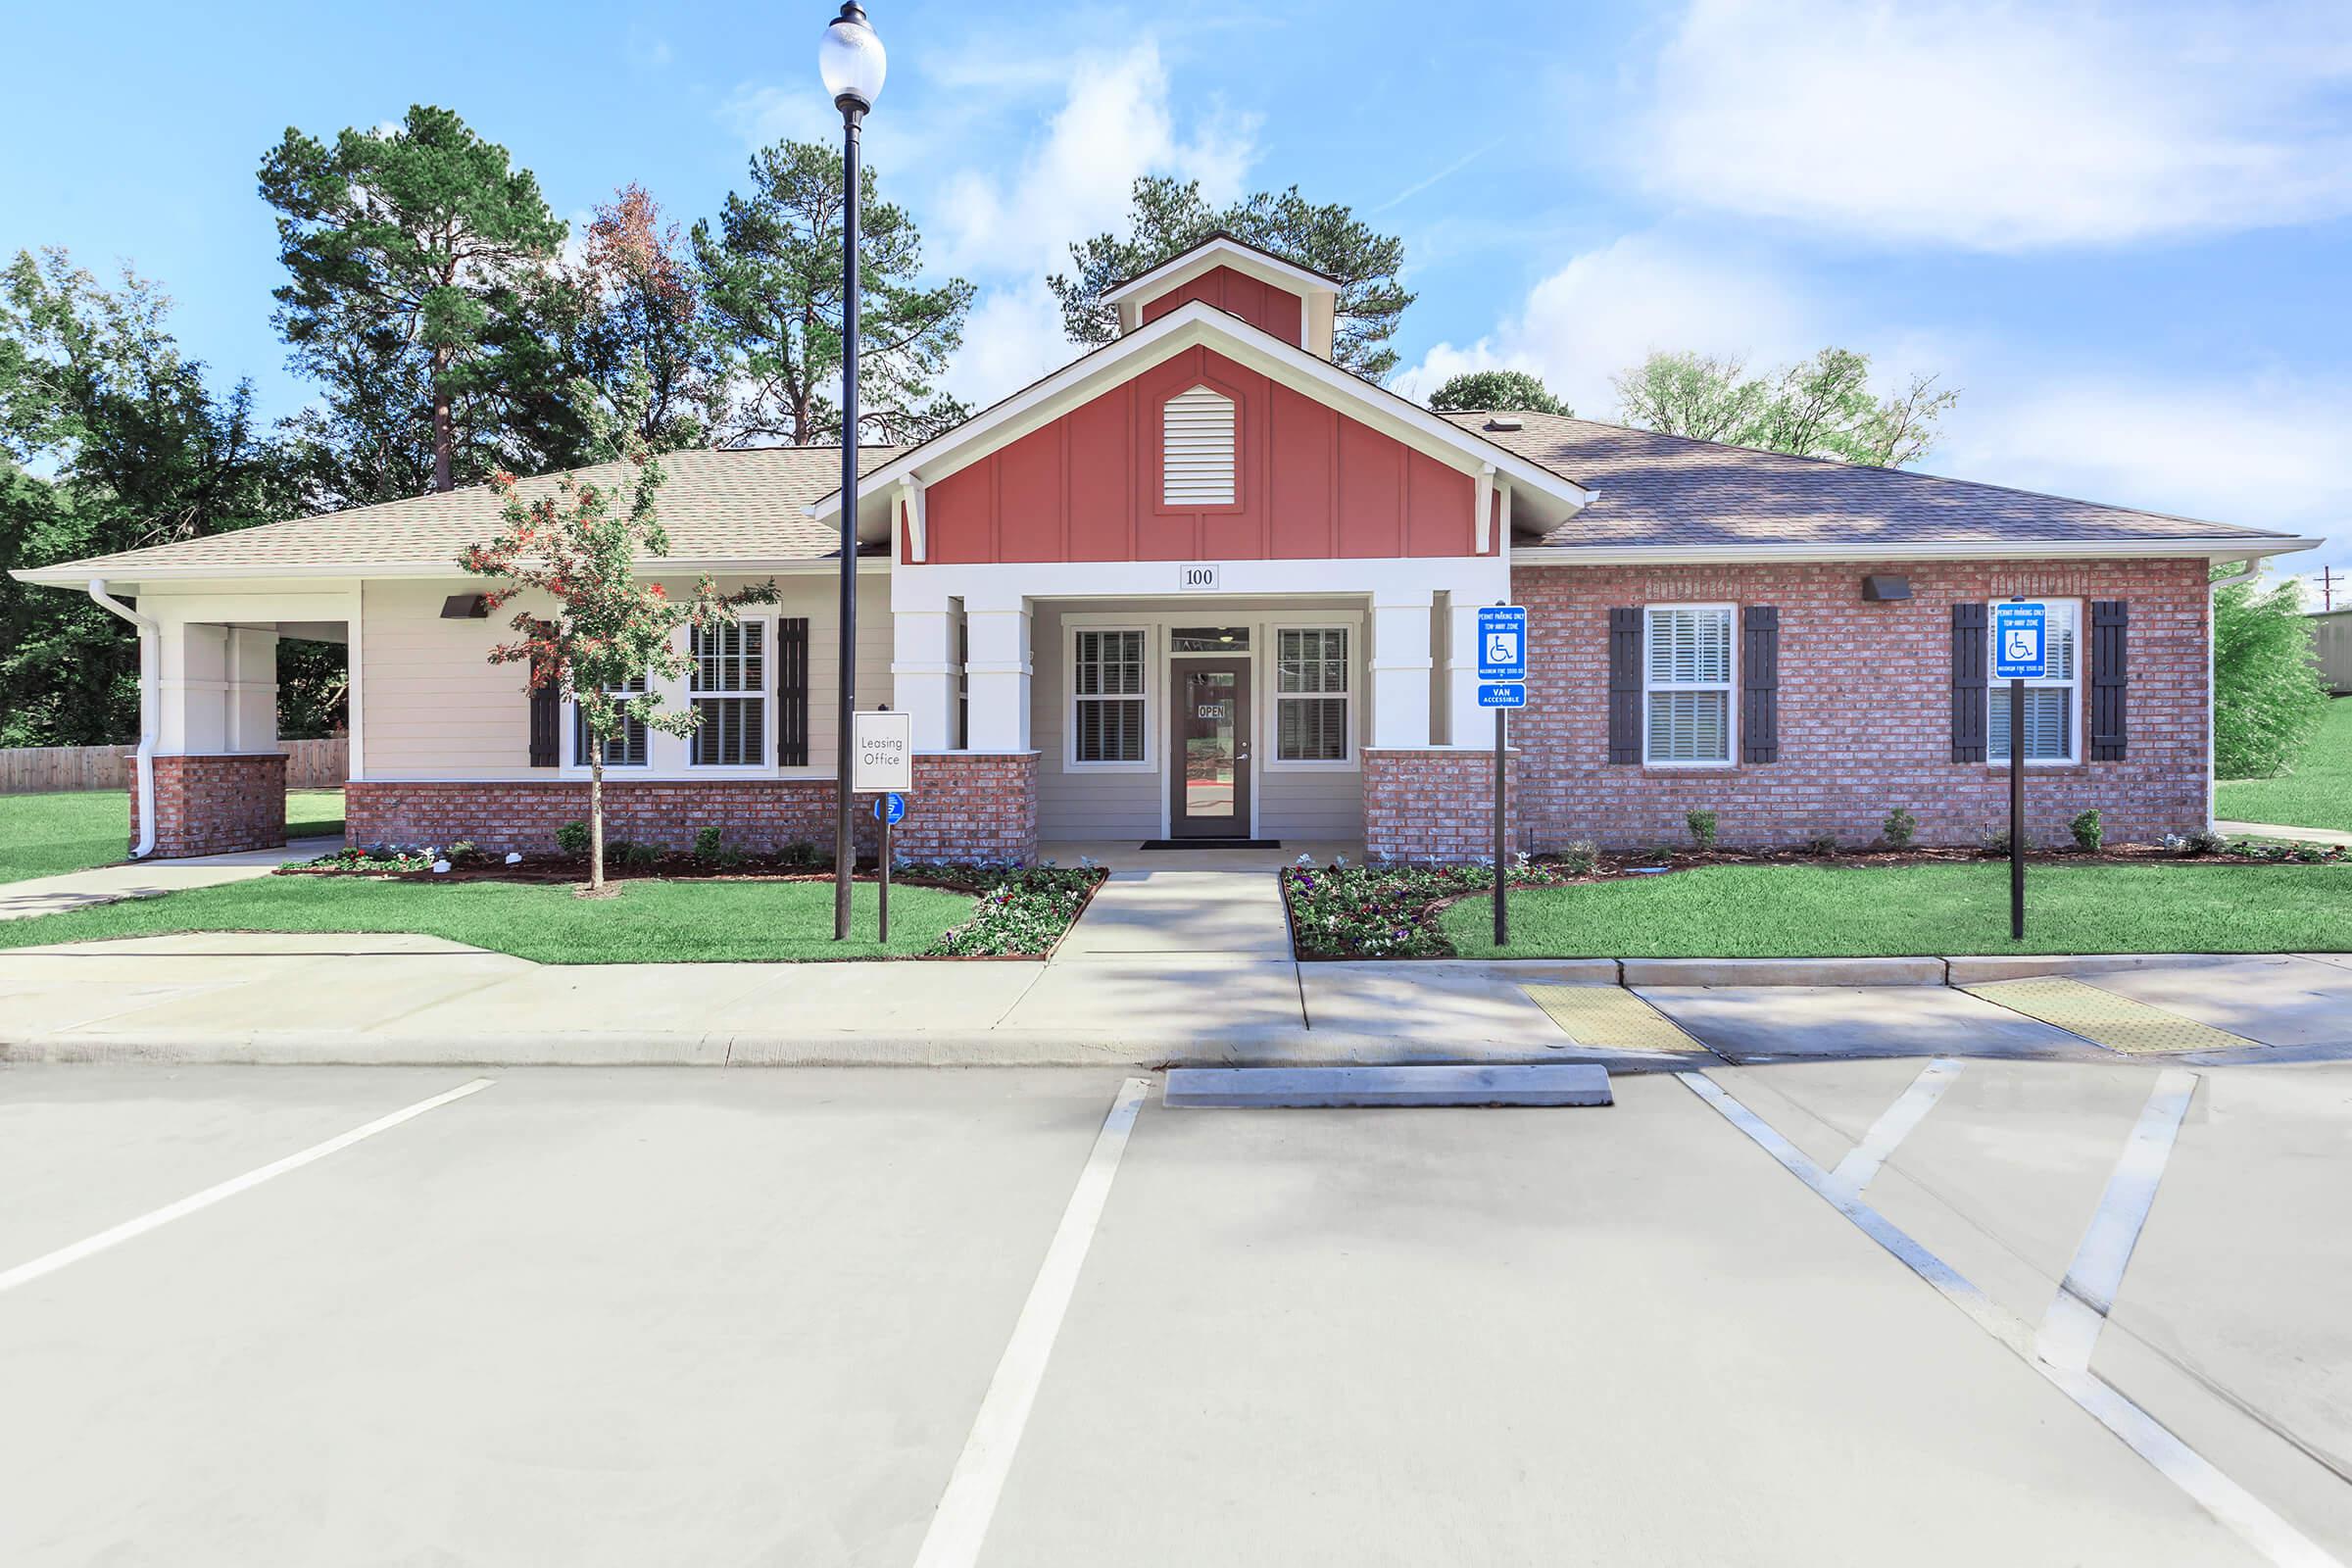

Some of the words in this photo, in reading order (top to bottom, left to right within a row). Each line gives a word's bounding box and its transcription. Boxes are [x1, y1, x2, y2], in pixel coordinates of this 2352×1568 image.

[1187, 569, 1212, 585] 100
[1200, 706, 1223, 716] OPEN
[861, 736, 903, 751] Leasing
[863, 752, 900, 765] Office
